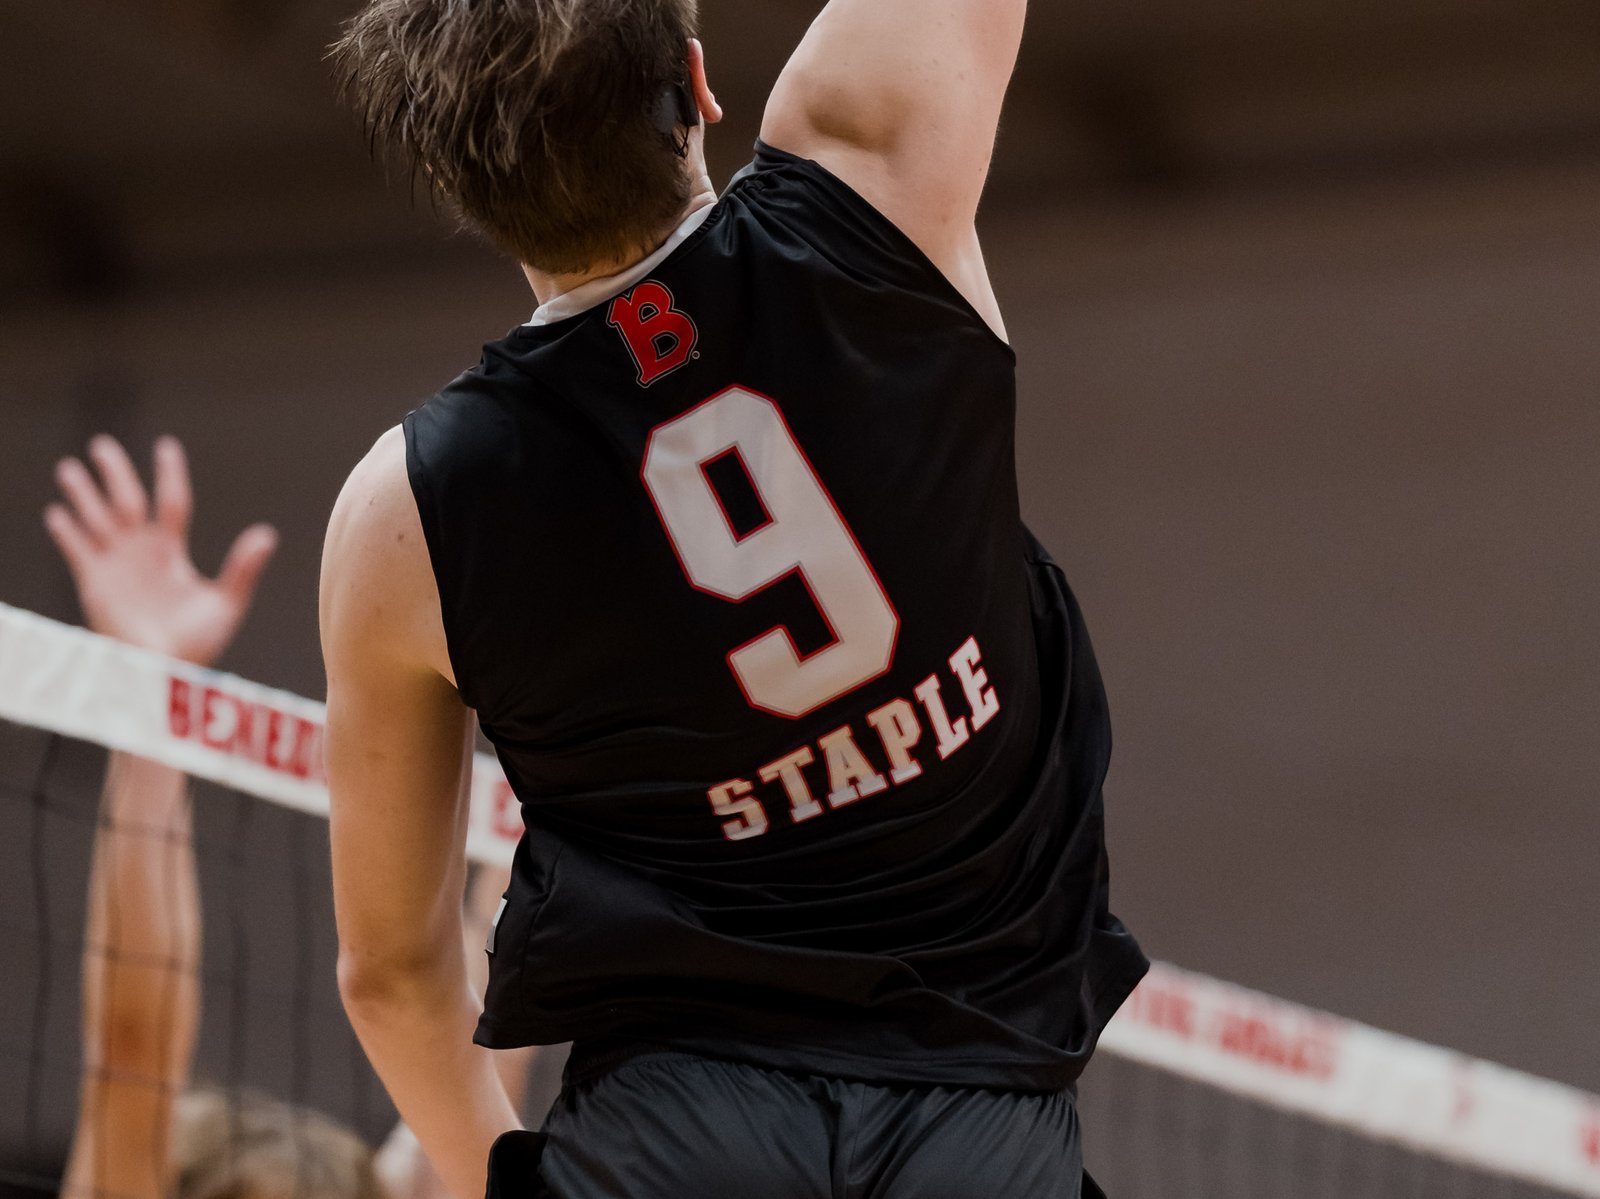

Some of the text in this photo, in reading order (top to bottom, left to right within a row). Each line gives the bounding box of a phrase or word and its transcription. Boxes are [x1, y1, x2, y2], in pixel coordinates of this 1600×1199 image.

[606, 279, 699, 388] B
[640, 383, 900, 720] 9
[706, 635, 1001, 842] STAPLE
